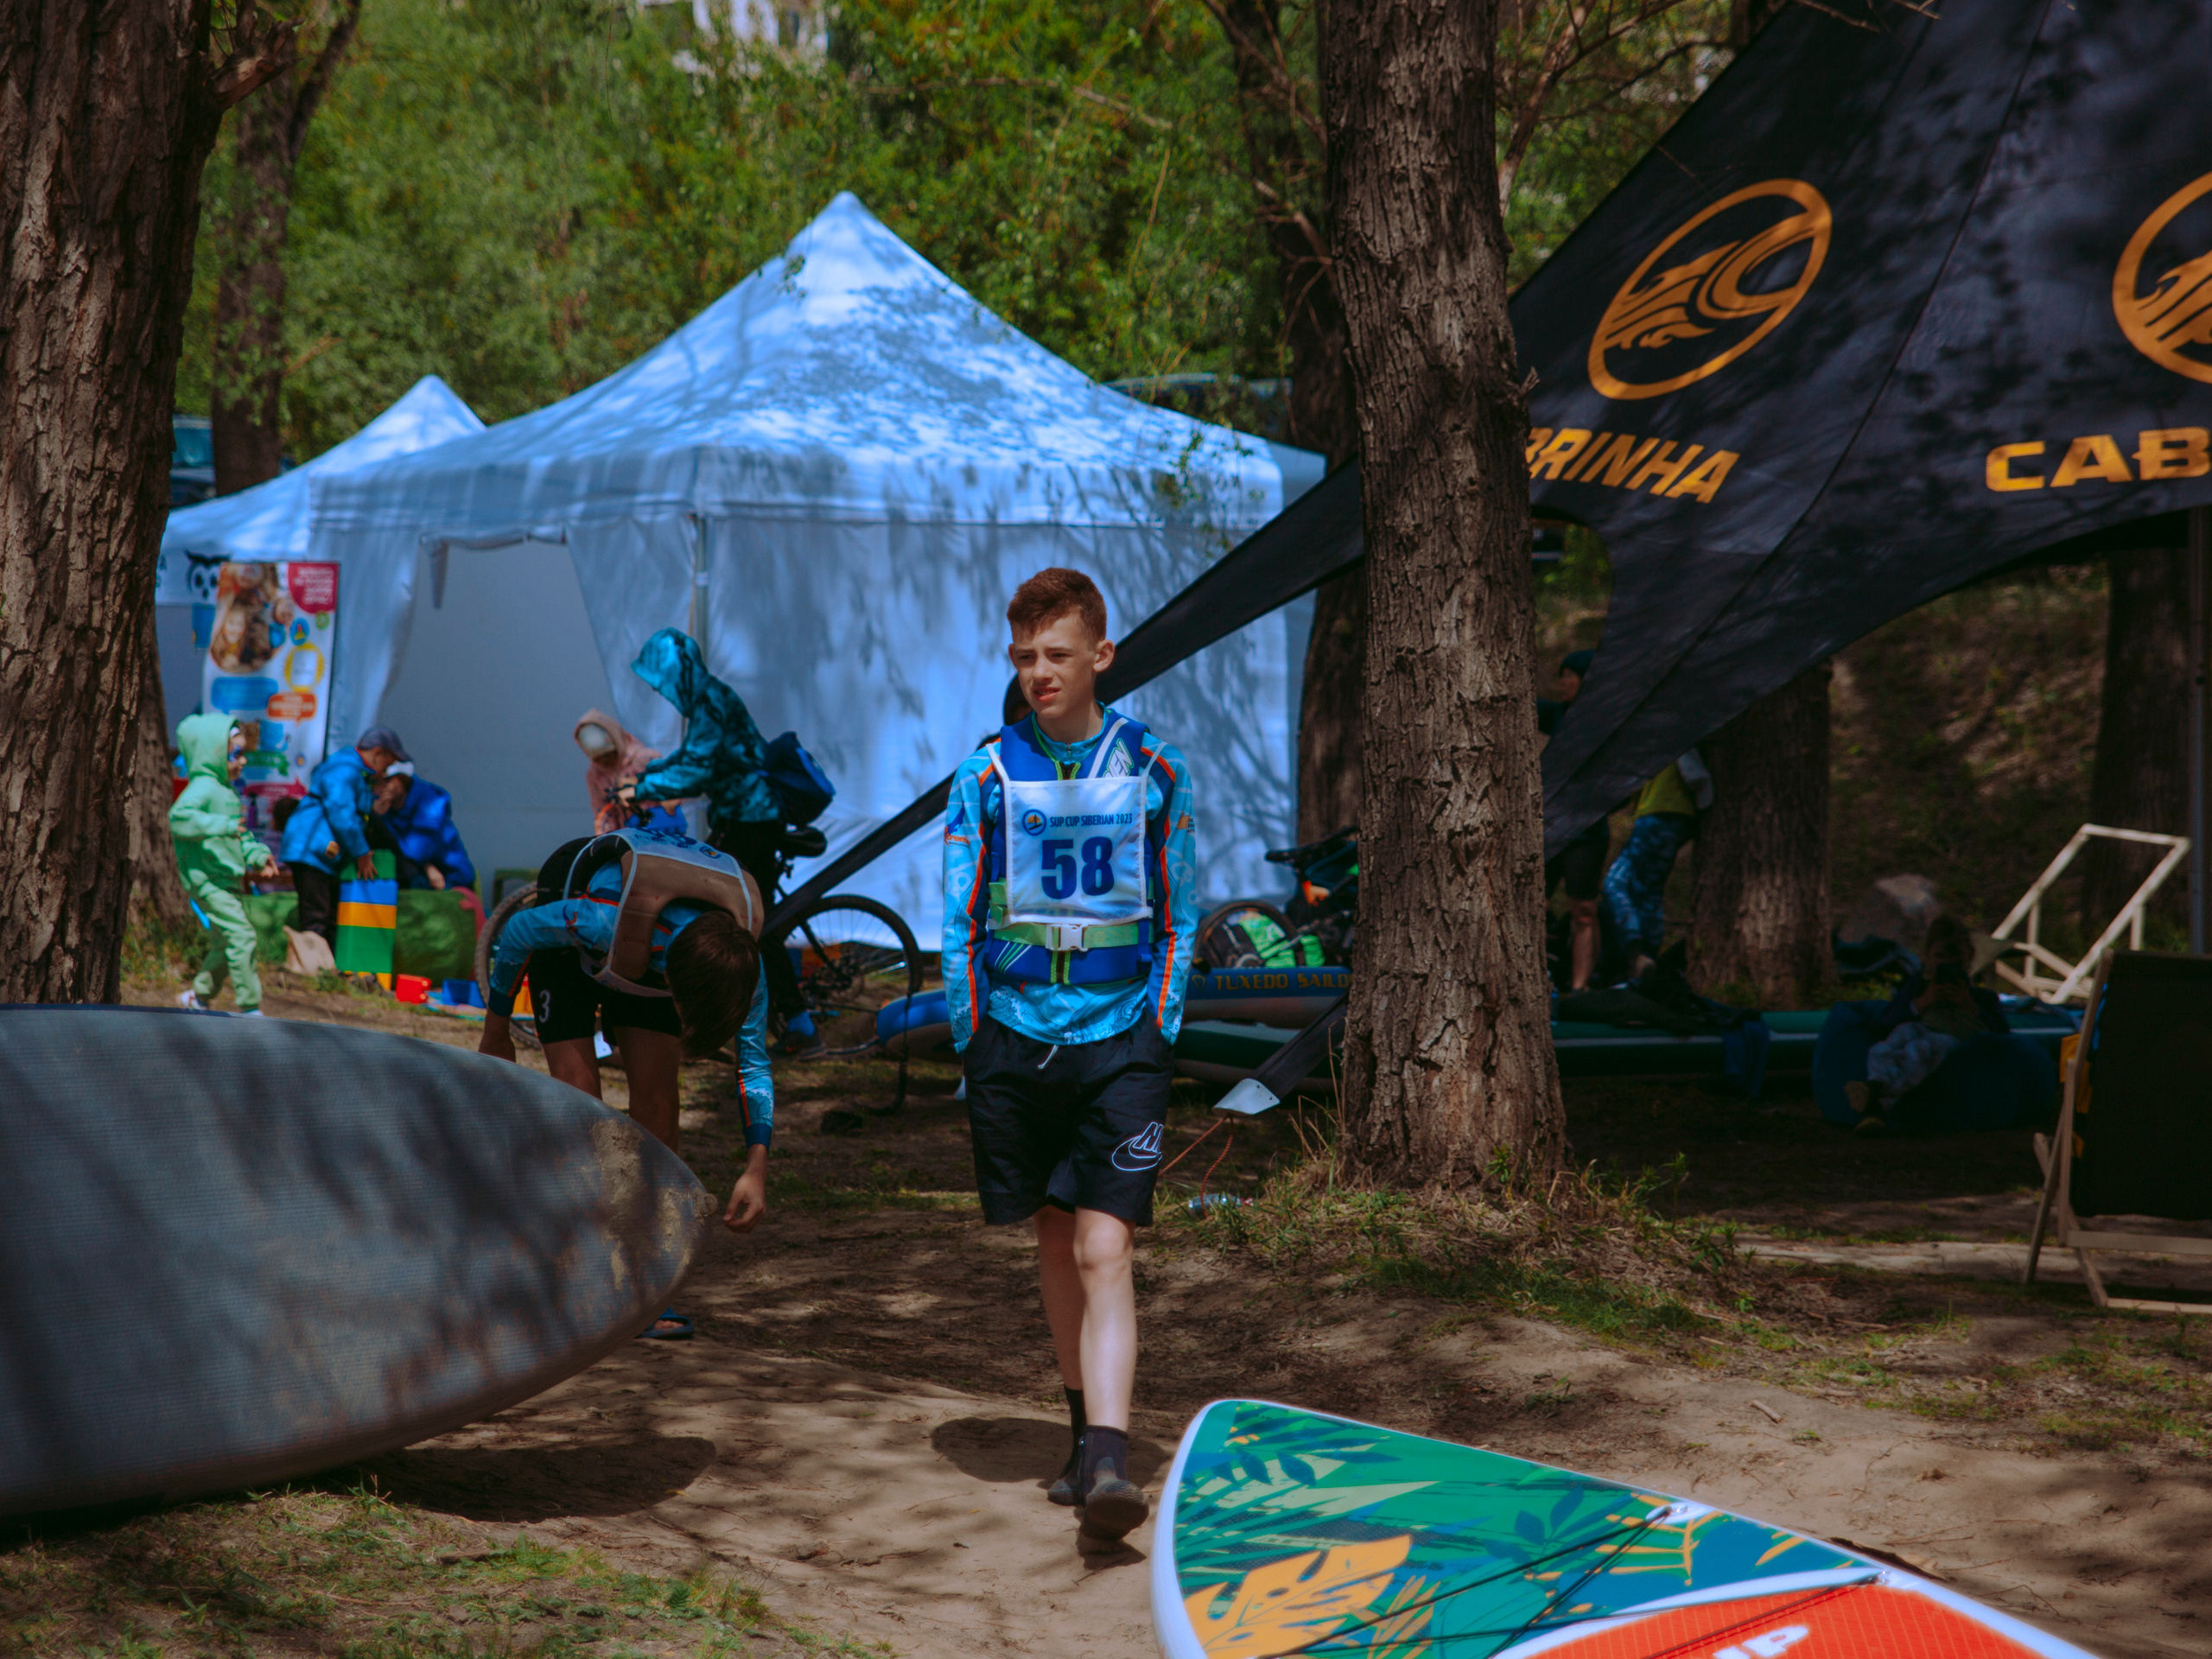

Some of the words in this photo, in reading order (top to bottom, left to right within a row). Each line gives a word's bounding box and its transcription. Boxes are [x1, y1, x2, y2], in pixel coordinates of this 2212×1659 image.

[1986, 426, 2212, 493] CAB
[1049, 816, 1065, 828] SUP
[1065, 815, 1080, 827] CUP
[1080, 813, 1115, 827] SIBERIAN
[1116, 812, 1133, 824] 2023
[1040, 836, 1116, 900] 58
[1214, 973, 1289, 991] TUXEDO
[1297, 972, 1354, 989] SAILO
